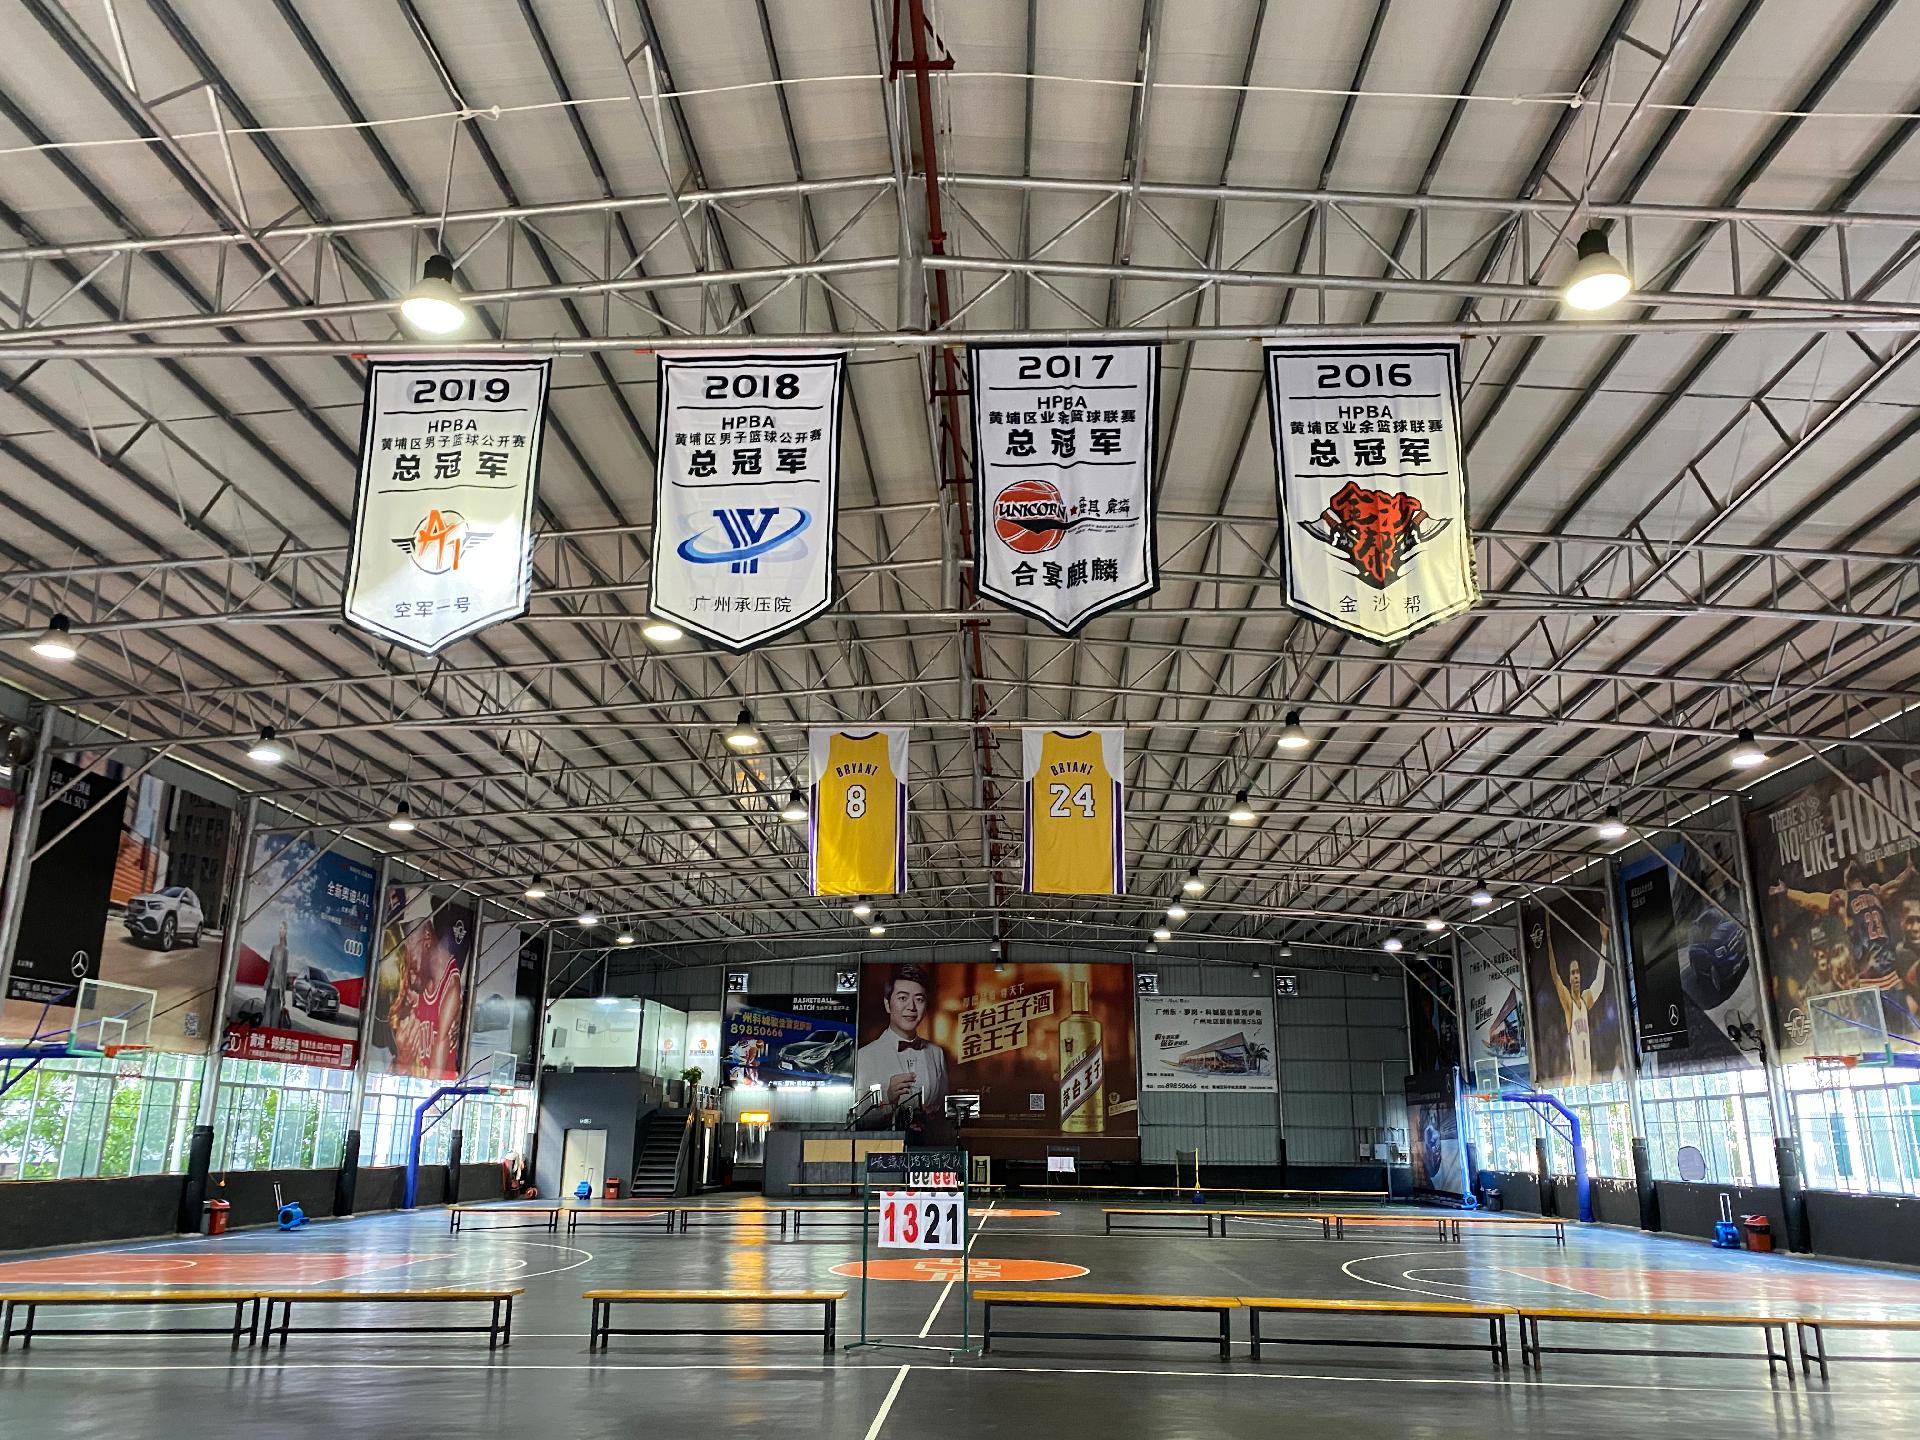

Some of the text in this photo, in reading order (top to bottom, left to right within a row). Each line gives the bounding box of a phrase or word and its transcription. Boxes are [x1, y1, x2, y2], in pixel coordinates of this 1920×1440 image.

[1018, 354, 1114, 379] 2017
[1317, 364, 1412, 389] 2016
[414, 378, 510, 404] 2019
[705, 373, 800, 400] 2018
[1037, 395, 1087, 410] HPBA
[1338, 405, 1393, 419] HPBA
[428, 419, 478, 434] HPBA
[721, 415, 775, 430] HPBA
[989, 410, 1136, 424] 黄埔区业余篮球联赛
[1290, 420, 1443, 434] 黄埔区业余篮球联赛
[381, 434, 526, 451] 黄埔区男子篮球公开赛
[674, 428, 822, 446] 黄埔区男子篮球公开赛
[1005, 427, 1122, 458] 总冠军
[688, 447, 807, 477] 总冠军
[1309, 439, 1432, 467] 总冠军
[392, 450, 510, 482] 总冠军
[998, 502, 1067, 521] UNICORN
[394, 597, 471, 618] 空军一号
[693, 597, 792, 612] 广州承压院
[1339, 594, 1421, 613] 金沙帮
[836, 763, 879, 778] BRYANT
[1050, 762, 1095, 776] BRYANT
[846, 784, 867, 819] 8
[1050, 783, 1095, 817] 24
[1768, 802, 1807, 834] THERE'S
[1777, 816, 1826, 866] NO PLACE
[1799, 832, 1838, 878] LIKE
[961, 992, 1051, 1034] 茅台王子酒
[731, 1023, 783, 1038] 89850666
[961, 1027, 1024, 1064] 金王子
[1063, 1058, 1100, 1110] 茅台王子
[884, 1201, 958, 1244] 13 21
